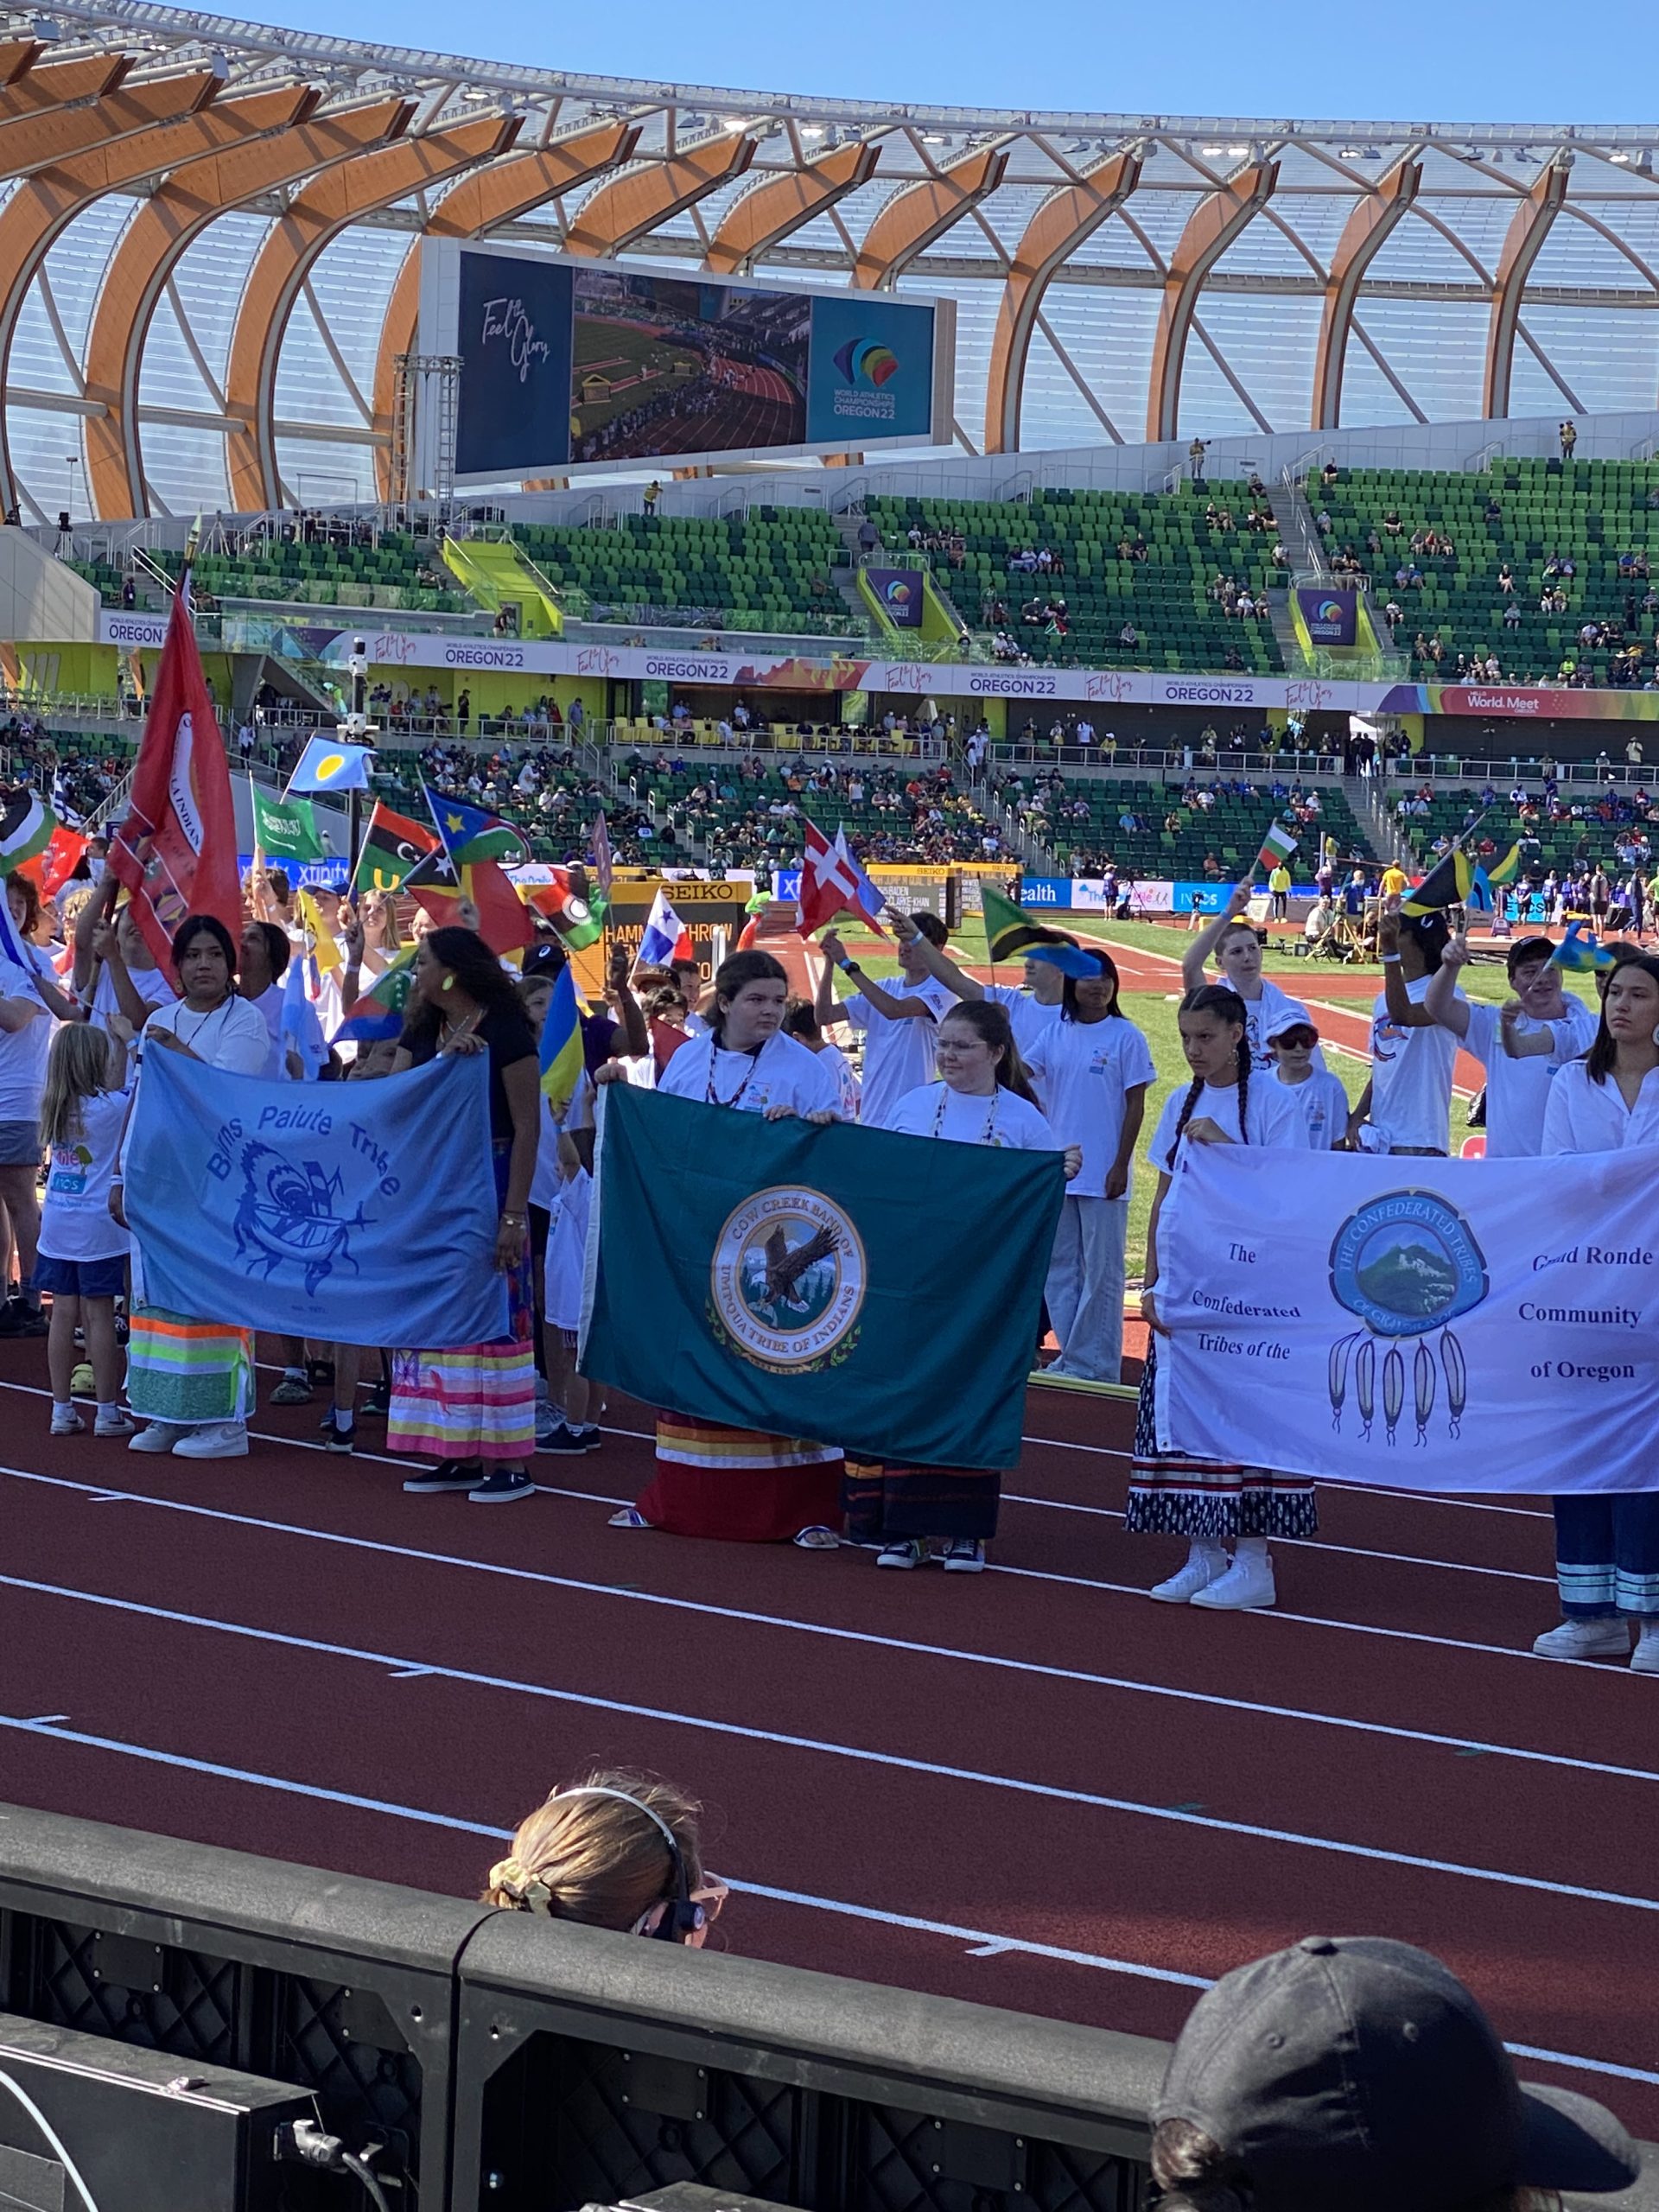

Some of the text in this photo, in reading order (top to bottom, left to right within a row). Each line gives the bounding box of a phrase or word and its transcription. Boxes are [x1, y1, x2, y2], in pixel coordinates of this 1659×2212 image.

[482, 298, 514, 344] Feel
[511, 315, 550, 382] Glory
[834, 389, 895, 401] WORLD ATHLETICS
[834, 397, 895, 409] CHAMPIONSHIPS
[110, 625, 162, 642] OREGON
[1507, 697, 1539, 709] Meet
[175, 797, 200, 847] INDIAN
[661, 884, 733, 899] SEIKO
[888, 887, 909, 895] BADEN
[1020, 884, 1057, 902] ealth
[258, 1104, 333, 1135] Paiute
[349, 1122, 401, 1196] Tribe
[732, 1197, 854, 1258] COW CREEK BAND OF
[1230, 1243, 1256, 1263] The
[1340, 1201, 1478, 1283] THE CONFEDERATED TRIBES
[1586, 1246, 1653, 1265] Ronde
[721, 1264, 855, 1353] UMPQUA TRIBE OF INDIANS
[1192, 1290, 1301, 1318] Confederated
[1518, 1302, 1642, 1329] Community
[1198, 1332, 1290, 1359] Tribes of the
[1530, 1361, 1635, 1382] of Oregon
